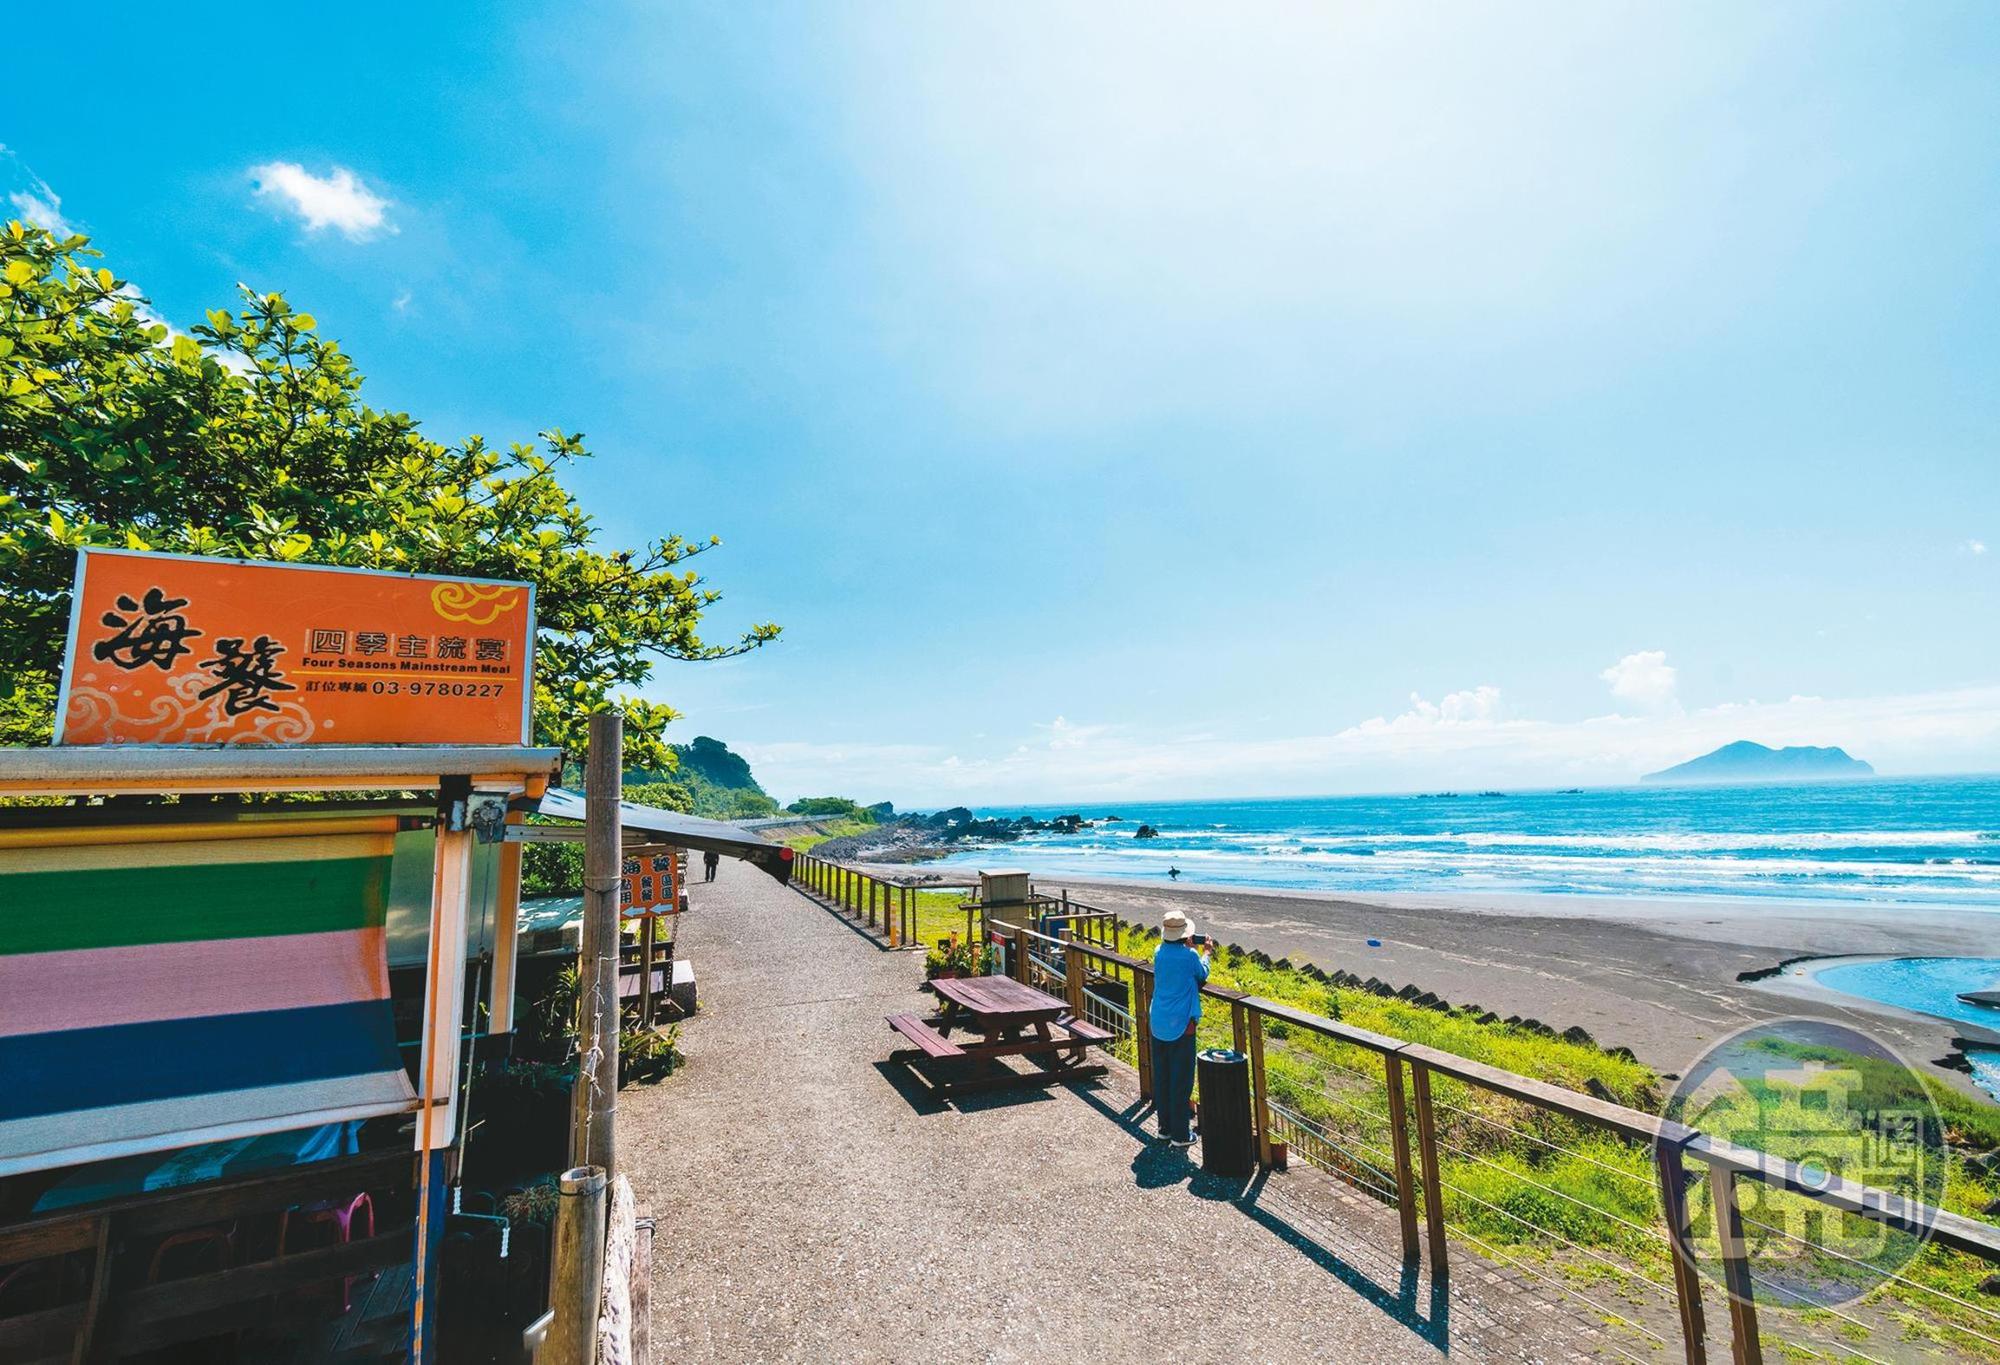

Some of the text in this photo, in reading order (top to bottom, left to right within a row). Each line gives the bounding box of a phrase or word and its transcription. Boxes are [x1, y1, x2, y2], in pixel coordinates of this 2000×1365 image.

[311, 628, 505, 661] 四季主流宴
[302, 657, 511, 674] Four Seasons Mainstream Meal
[305, 680, 505, 698] 訂位專線 03-9780227
